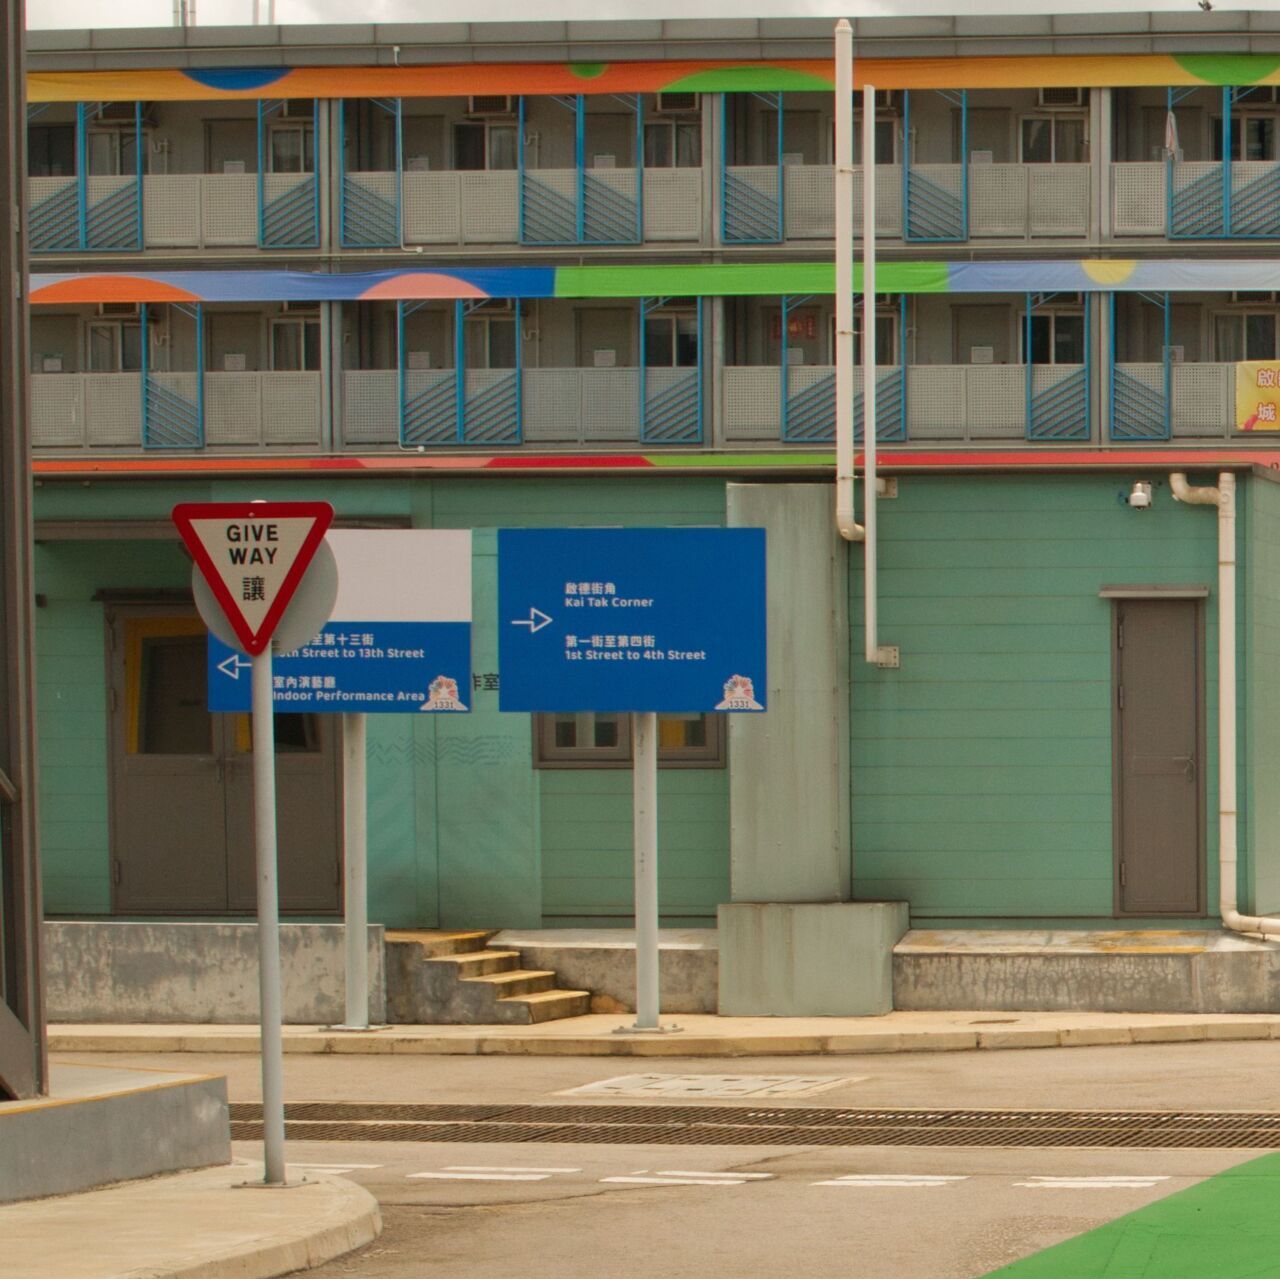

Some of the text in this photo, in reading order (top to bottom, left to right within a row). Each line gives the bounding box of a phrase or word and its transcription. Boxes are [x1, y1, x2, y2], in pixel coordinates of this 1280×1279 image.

[226, 524, 279, 542] GIVE
[228, 547, 278, 565] WAY
[242, 576, 265, 601] 讓
[564, 597, 654, 607] Kai Tak Corner
[565, 635, 655, 647] 第一街至第四街
[302, 648, 340, 658] Street
[343, 649, 355, 658] to
[359, 648, 384, 658] 13th
[387, 648, 425, 658] Street
[565, 650, 706, 660] 1st Street to 4th Street
[273, 690, 425, 701] Indoor Performance Area
[433, 700, 455, 709] 1331
[729, 700, 750, 709] 1331
